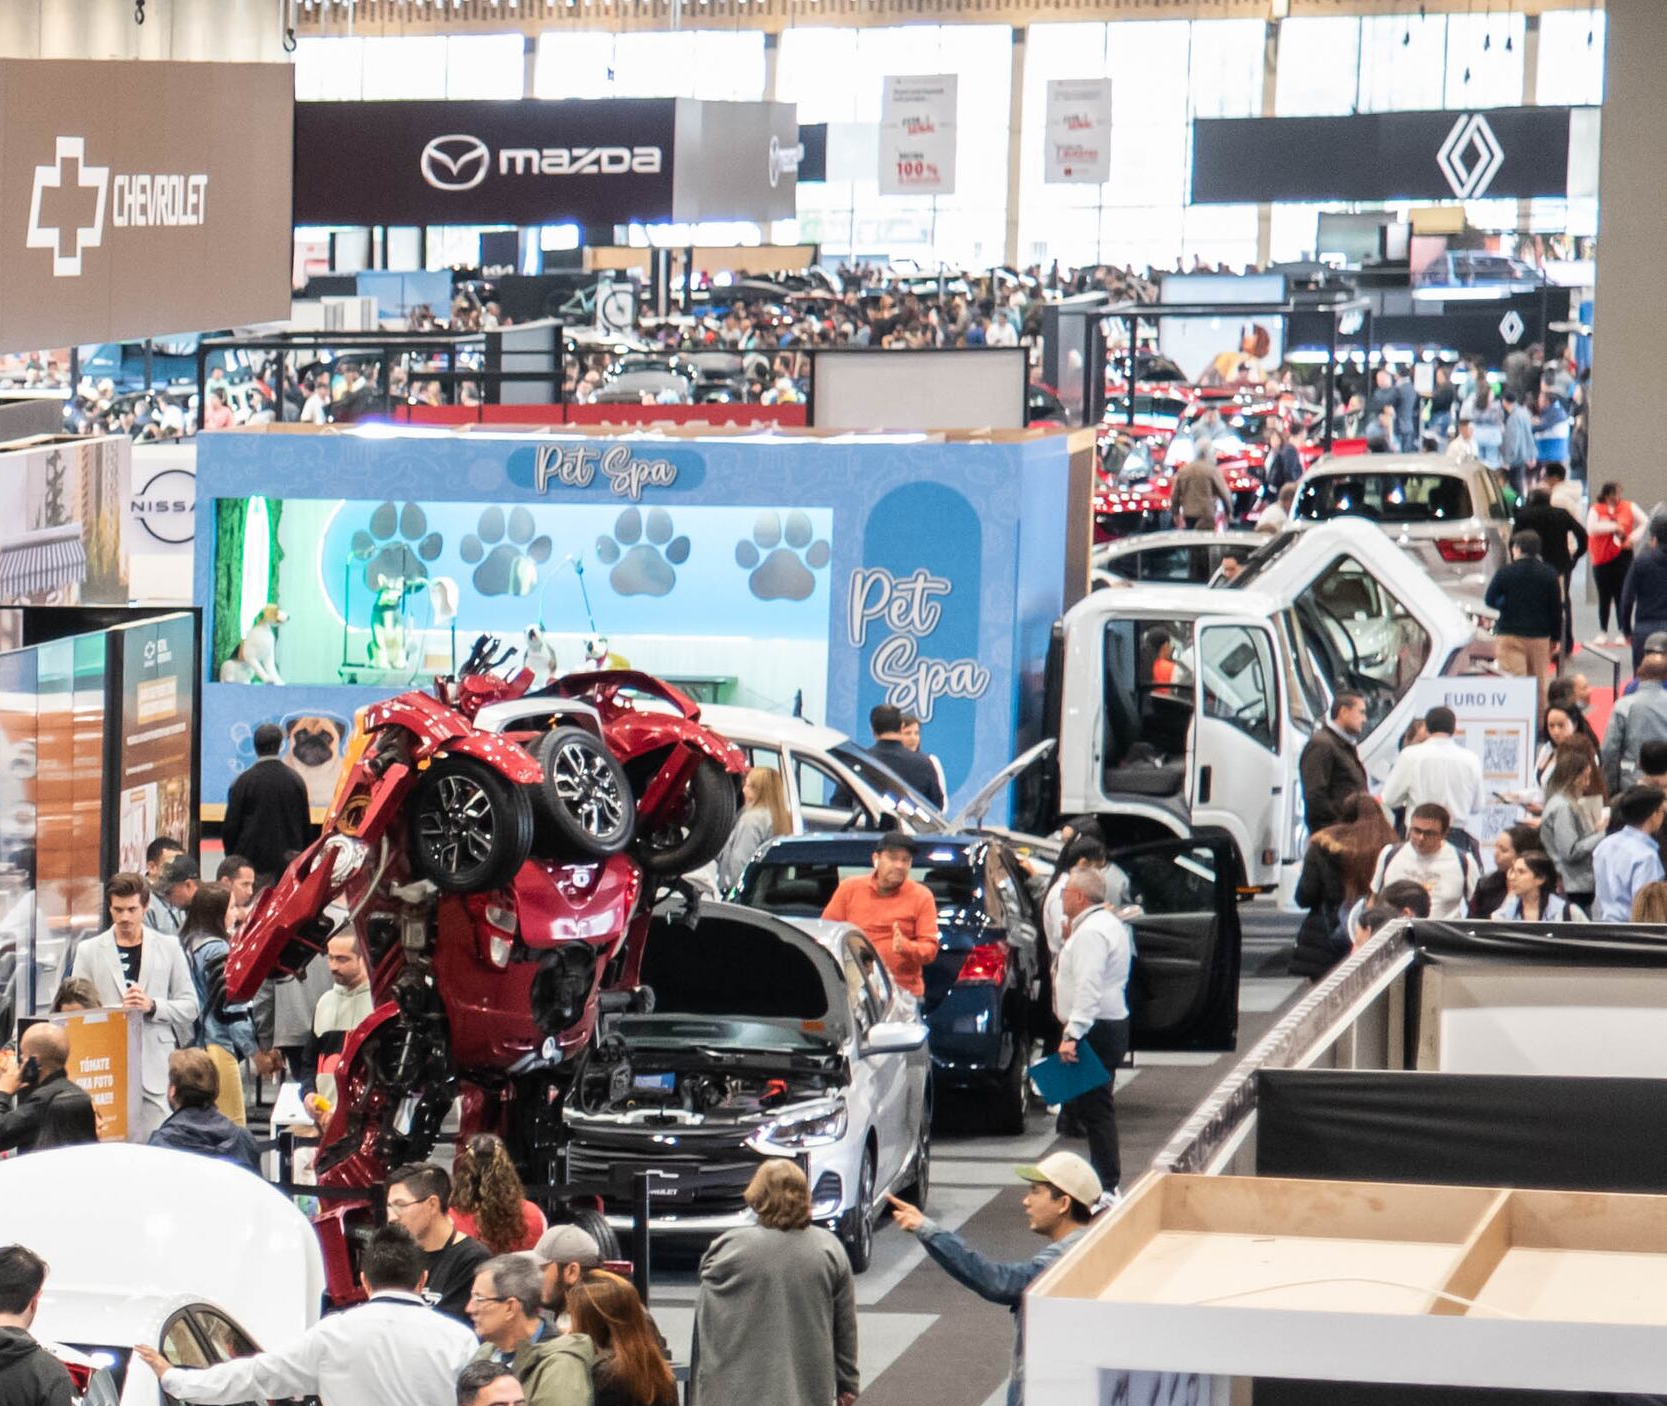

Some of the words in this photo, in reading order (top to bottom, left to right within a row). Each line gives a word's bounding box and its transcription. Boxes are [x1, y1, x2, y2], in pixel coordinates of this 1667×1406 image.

[113, 174, 209, 227] CHEVROLET
[534, 443, 598, 497] Pet
[600, 444, 678, 502] Spa
[847, 566, 953, 648] Pet
[869, 633, 991, 724] Spa
[1444, 692, 1486, 707] EURO
[1492, 693, 1508, 707] IV
